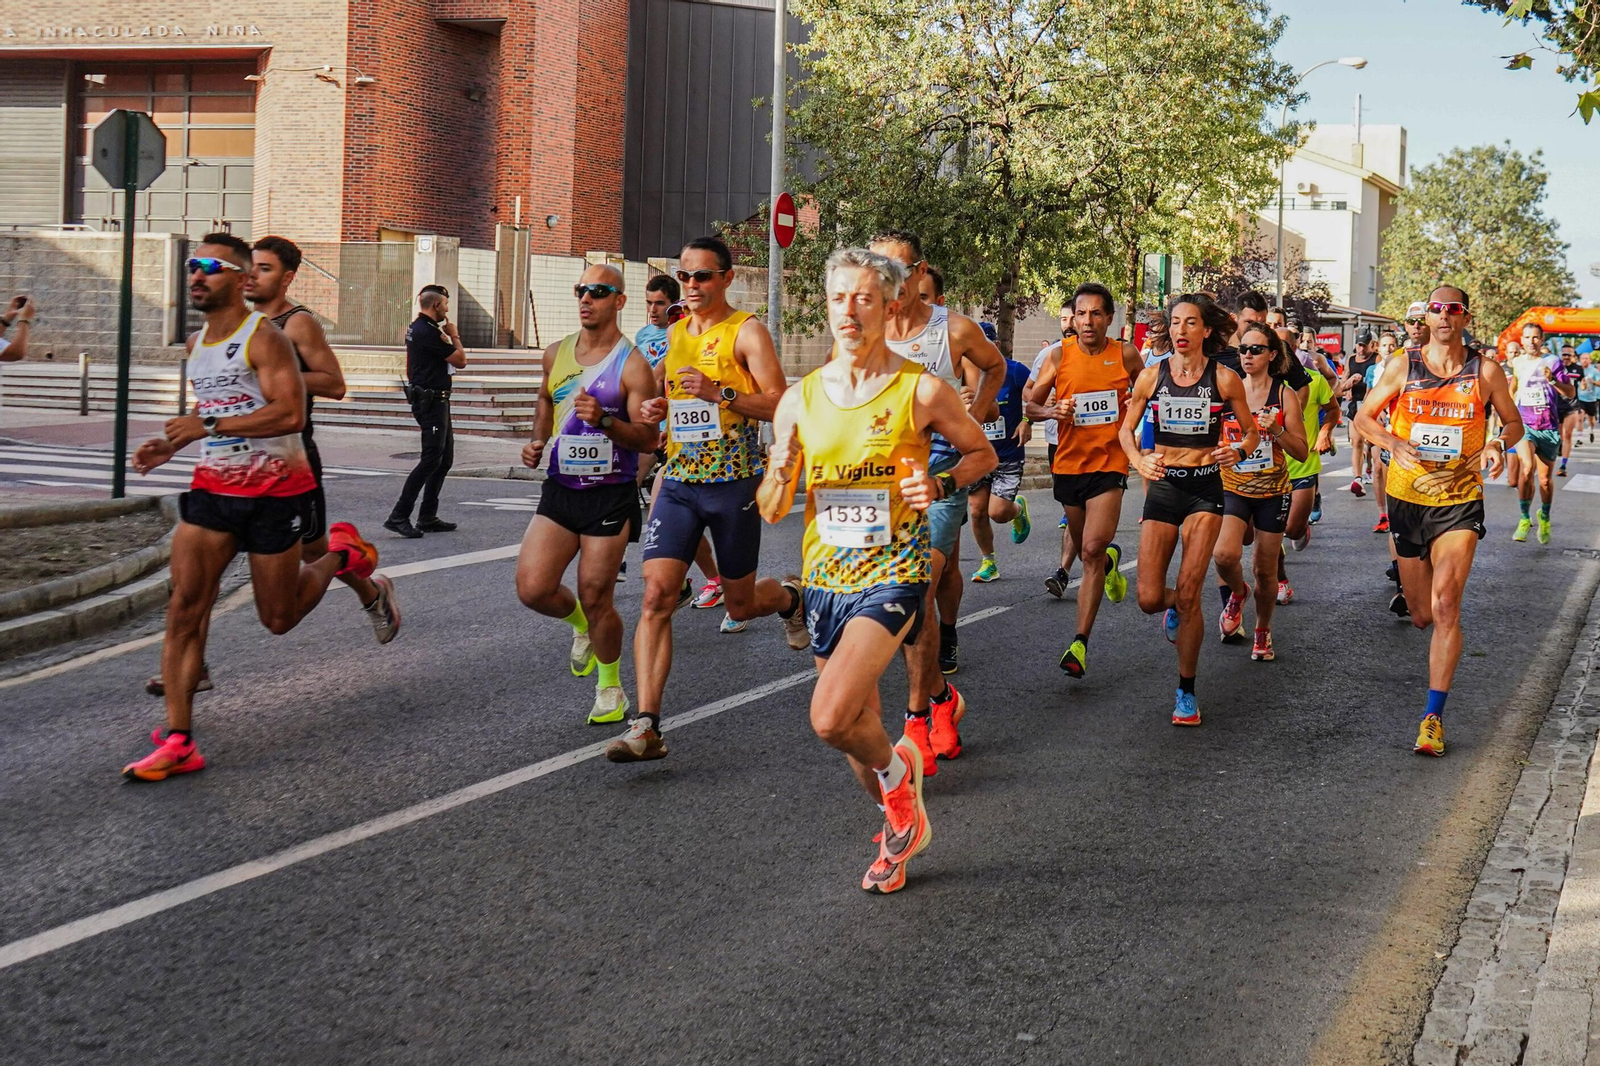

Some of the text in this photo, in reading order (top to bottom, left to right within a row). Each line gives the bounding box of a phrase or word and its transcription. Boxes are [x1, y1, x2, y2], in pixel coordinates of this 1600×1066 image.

[5, 23, 263, 38] A INMACULADA NIÑA
[1083, 400, 1109, 412] 108
[1409, 397, 1475, 420] LA ZUBIA
[1432, 400, 1467, 409] Deportivo
[674, 410, 710, 425] 1380
[1165, 407, 1203, 420] 1185
[1421, 434, 1450, 447] 542
[568, 446, 599, 459] 390
[835, 461, 896, 482] Vigilsa
[1193, 461, 1220, 477] NIKE
[824, 505, 878, 523] 1533
